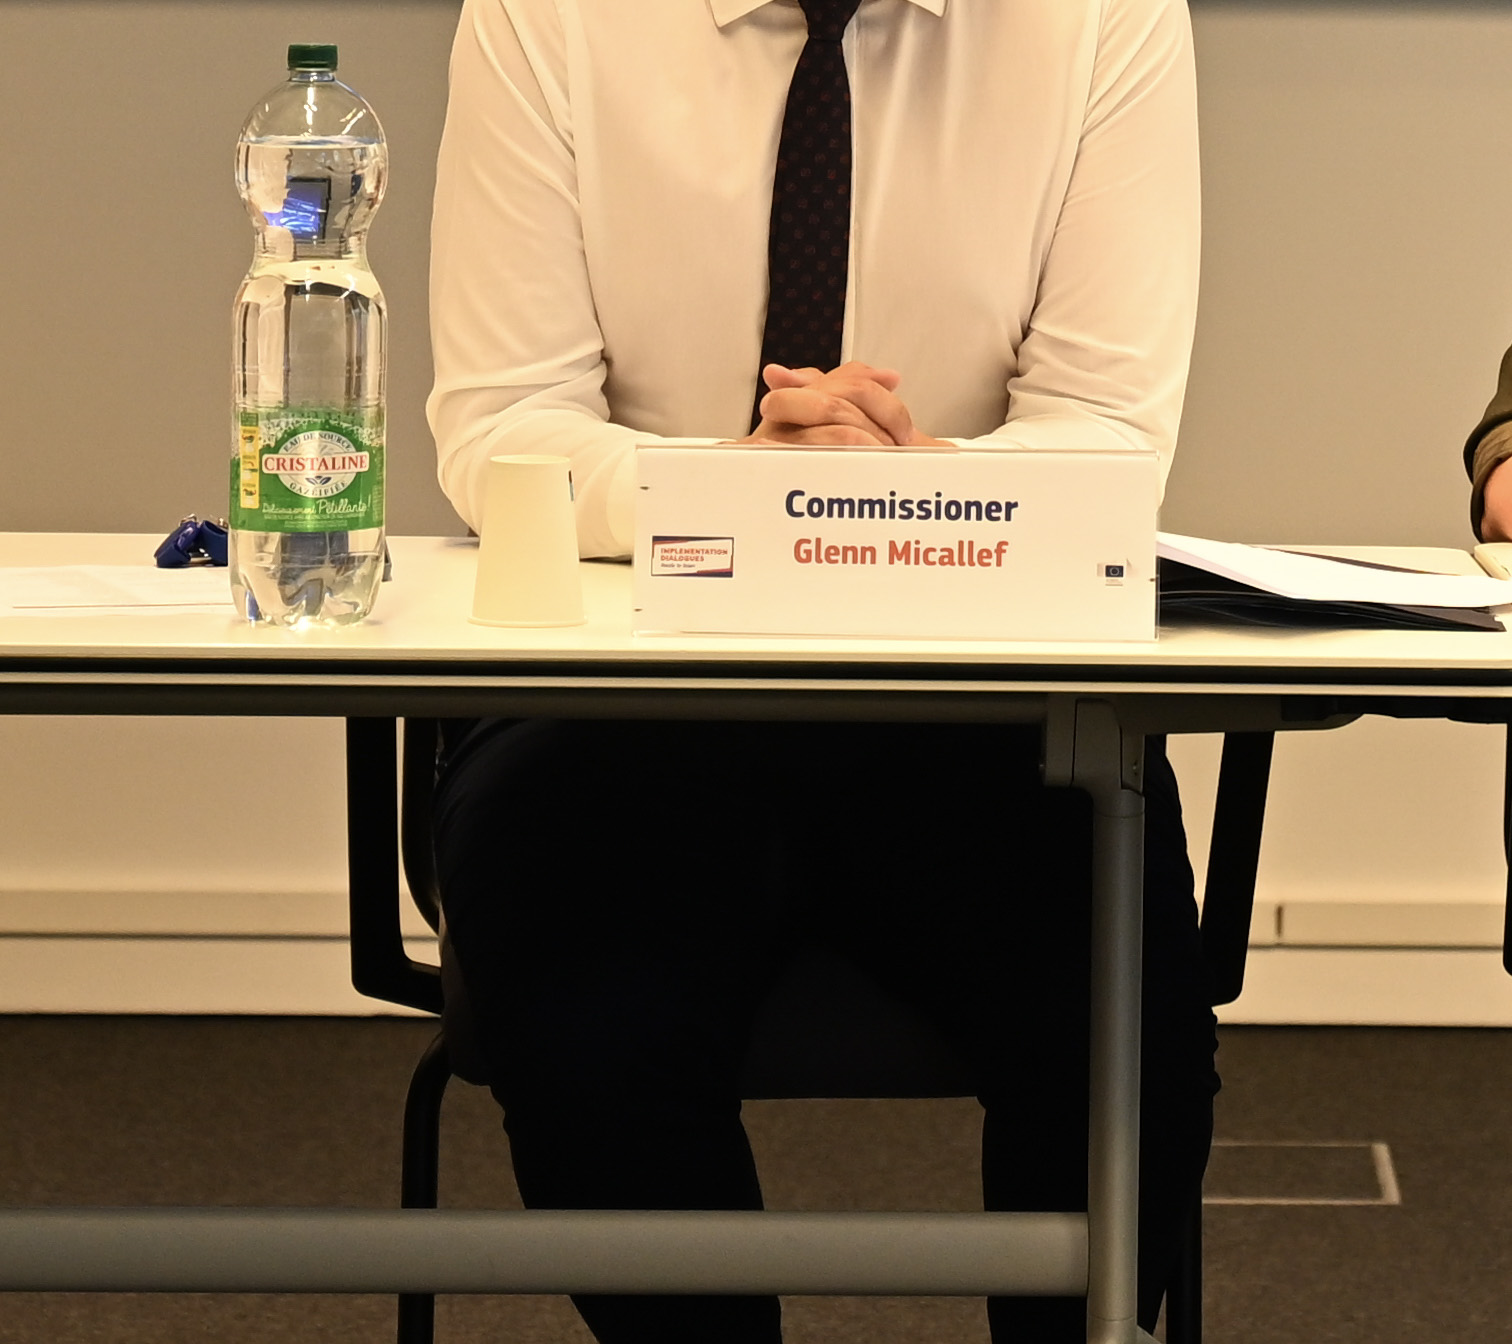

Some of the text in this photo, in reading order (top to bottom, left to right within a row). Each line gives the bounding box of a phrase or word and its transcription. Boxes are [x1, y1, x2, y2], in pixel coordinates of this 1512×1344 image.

[318, 432, 352, 451] SOURCE
[263, 454, 368, 472] CRISTALINE
[785, 490, 1018, 521] Commissioner
[793, 537, 1010, 567] Glenn Micallef
